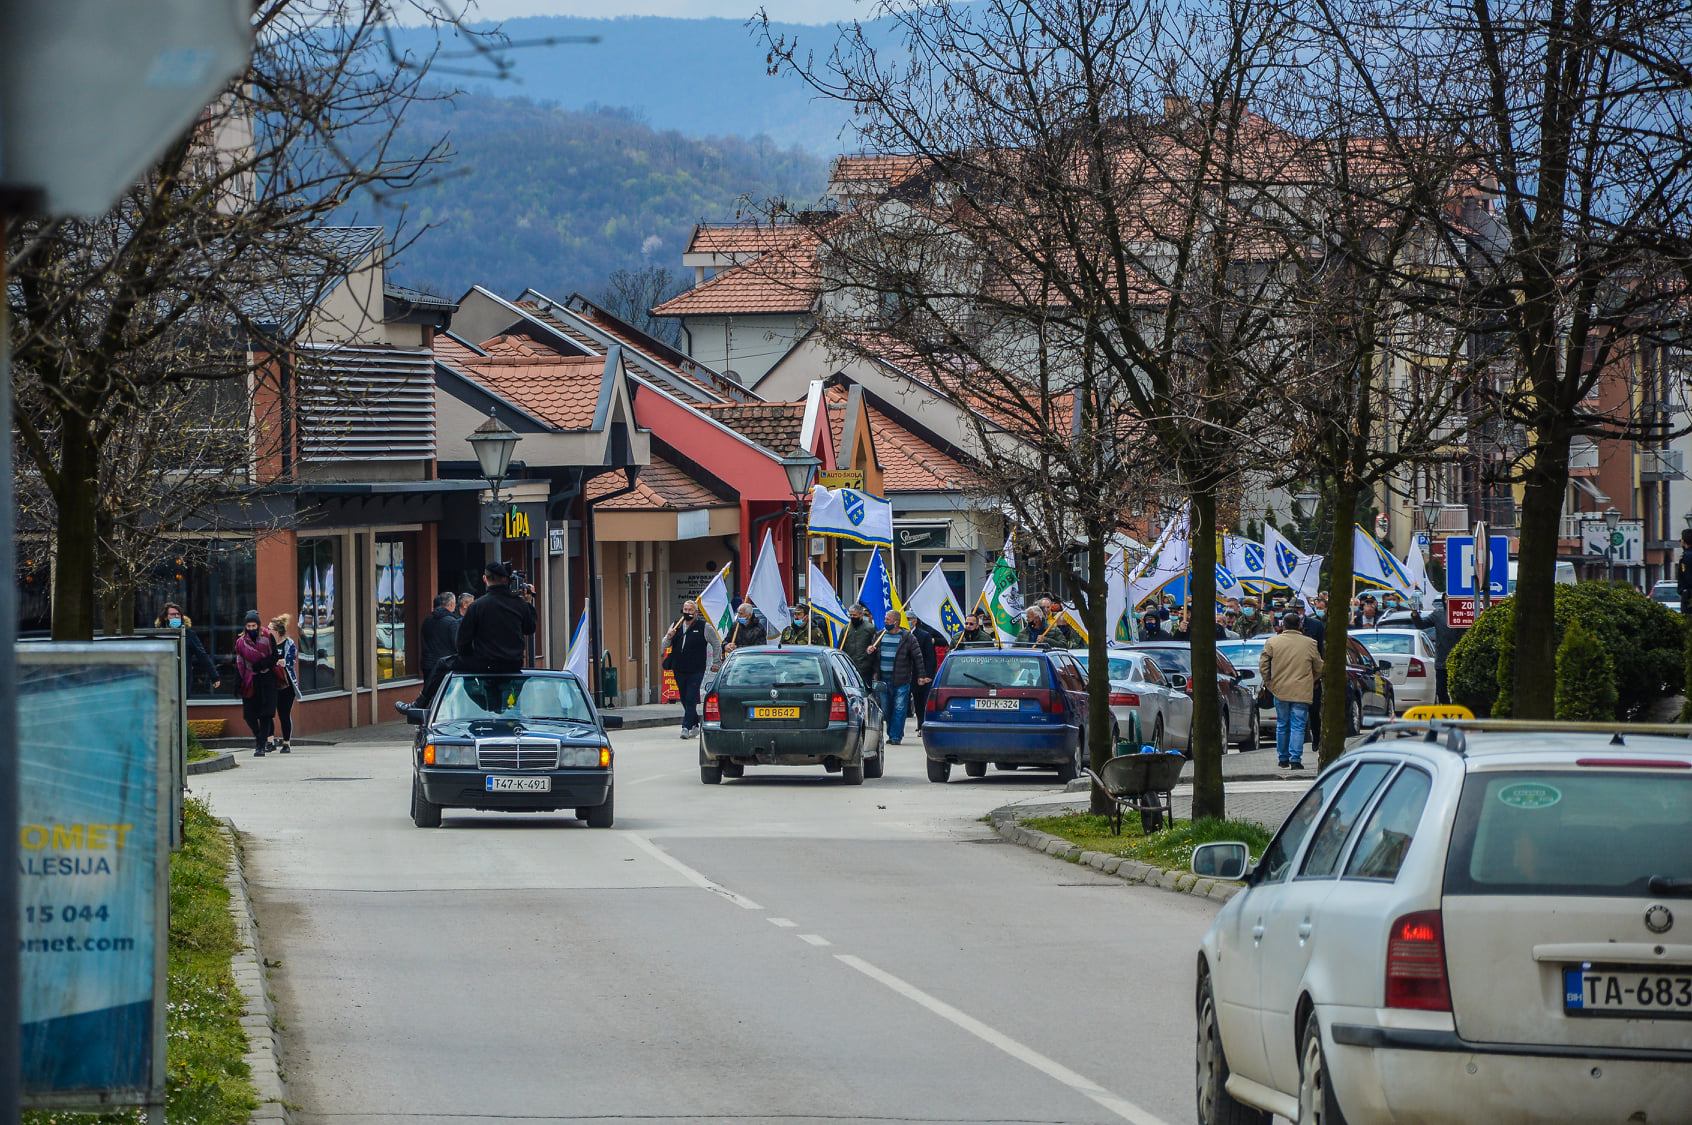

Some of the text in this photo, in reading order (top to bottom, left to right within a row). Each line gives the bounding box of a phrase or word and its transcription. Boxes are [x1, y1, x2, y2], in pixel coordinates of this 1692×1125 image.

[772, 709, 795, 717] 8642
[494, 778, 546, 790] T47-K-491
[62, 905, 110, 923] 044
